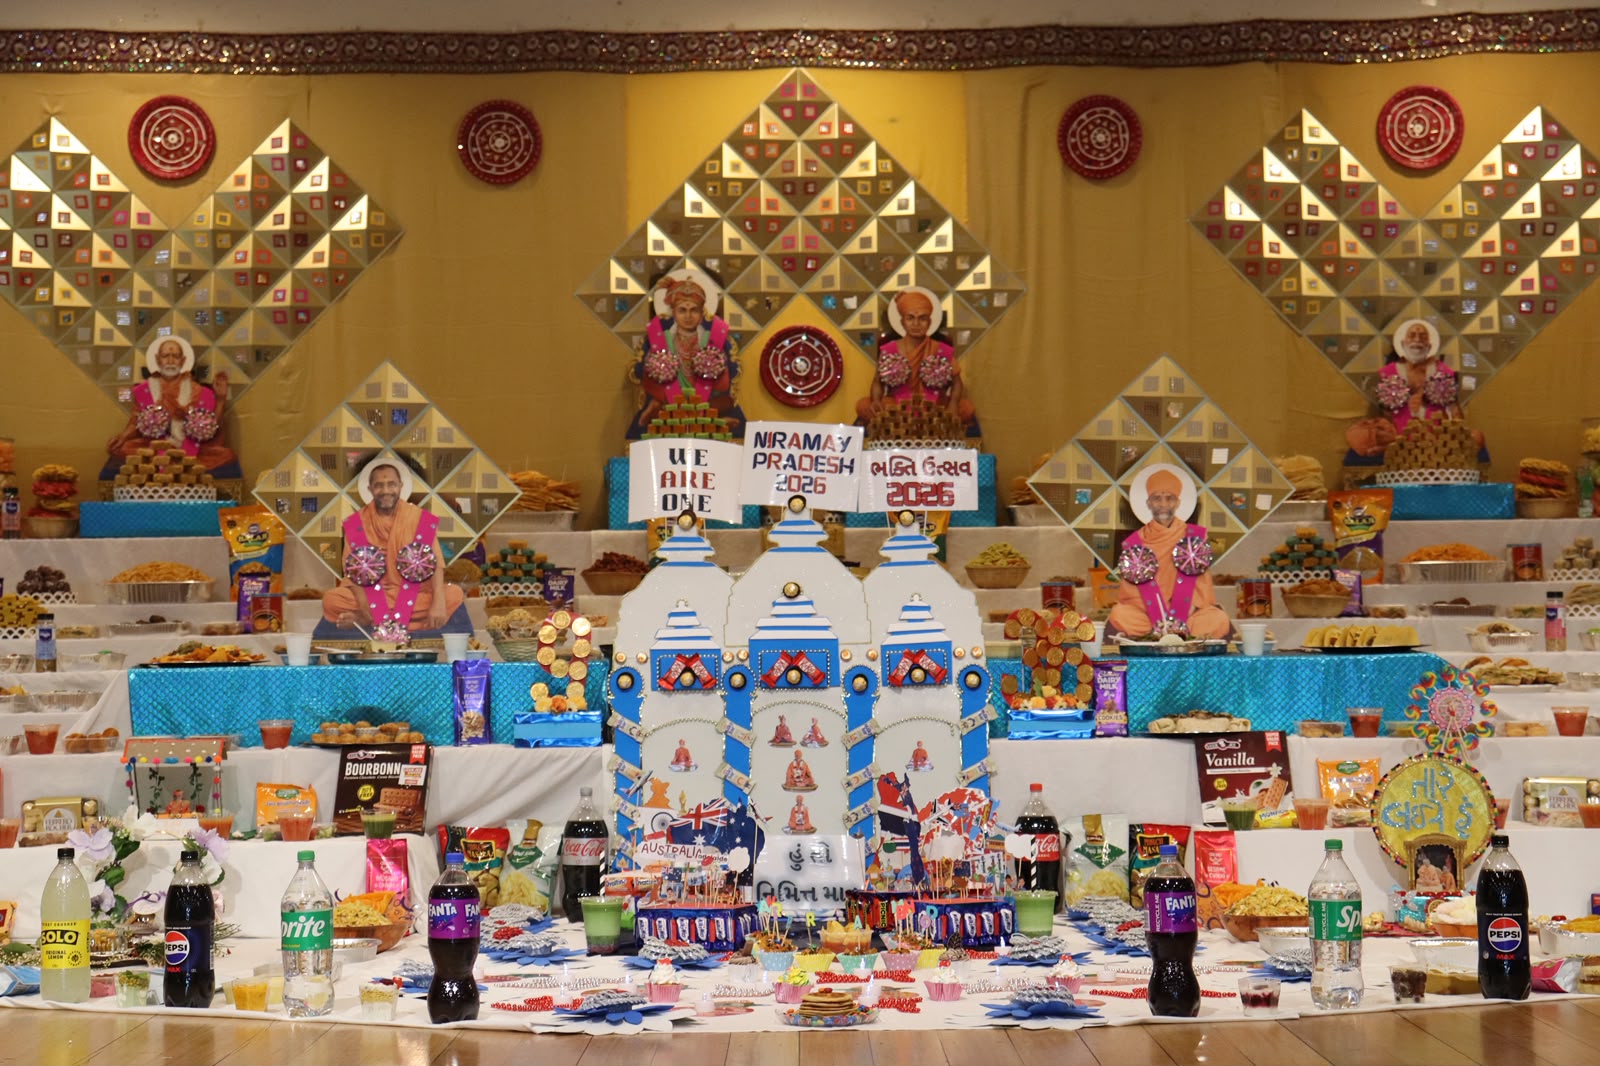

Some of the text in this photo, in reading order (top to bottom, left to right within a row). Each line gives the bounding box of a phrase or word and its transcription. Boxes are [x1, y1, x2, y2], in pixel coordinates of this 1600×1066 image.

[754, 432, 852, 452] NIRAMAY
[668, 448, 709, 466] WE
[752, 453, 854, 474] PRADESH
[870, 455, 972, 477] ભક્તિ ઉત્સવ
[660, 471, 716, 489] ARE
[775, 474, 827, 494] 2026
[662, 494, 712, 513] ONE
[887, 482, 955, 506] 2026
[1205, 752, 1255, 767] Vanilla
[789, 843, 805, 871] હું
[465, 901, 480, 917] FAN
[42, 931, 77, 944] SOLO
[1490, 930, 1520, 938] PEPSI
